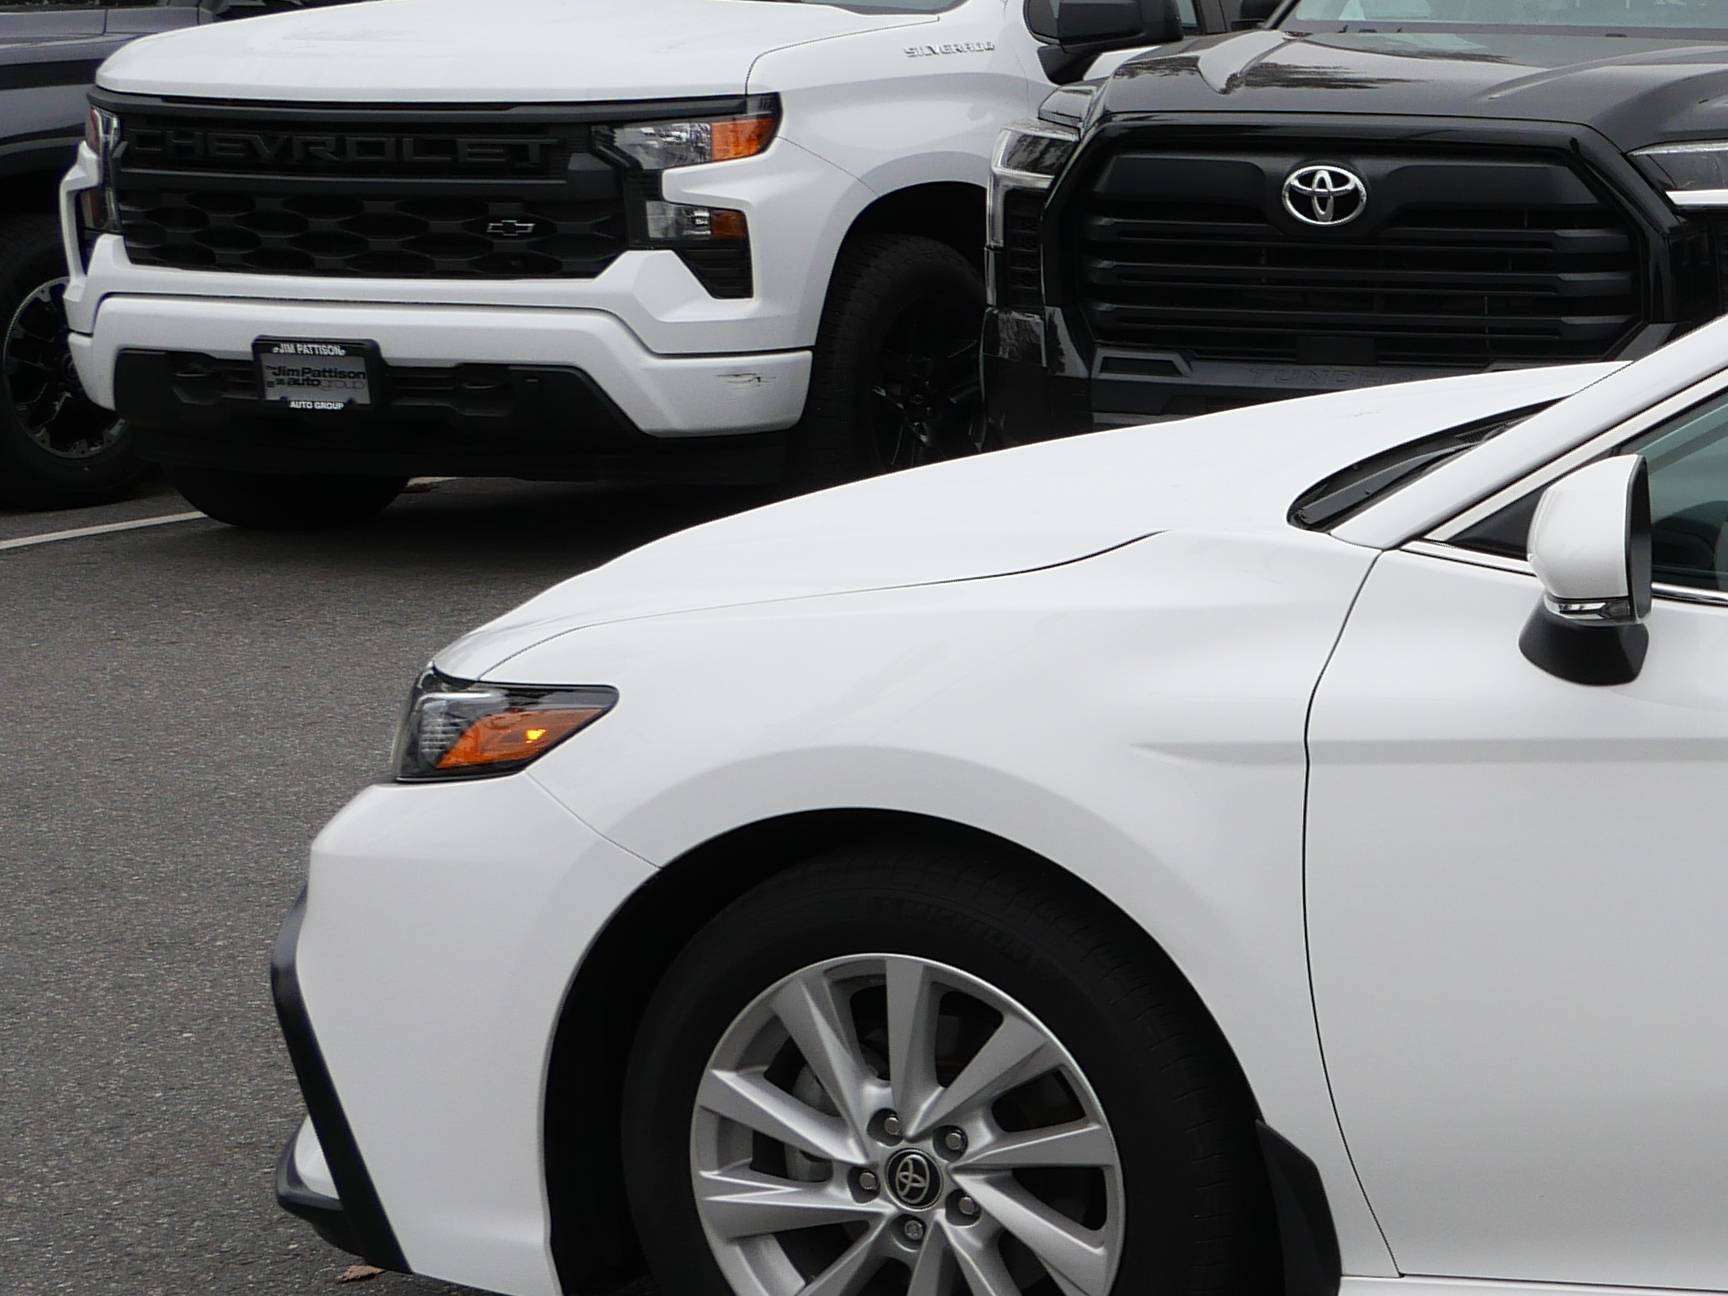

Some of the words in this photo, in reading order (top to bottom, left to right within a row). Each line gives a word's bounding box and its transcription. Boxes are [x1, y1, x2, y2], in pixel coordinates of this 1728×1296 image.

[904, 41, 995, 58] SILVERADO
[128, 127, 560, 167] CHEVROLET
[279, 343, 296, 354] JIM
[297, 344, 341, 356] PATTISON
[289, 401, 314, 409] AUTO
[314, 401, 345, 410] GROUP
